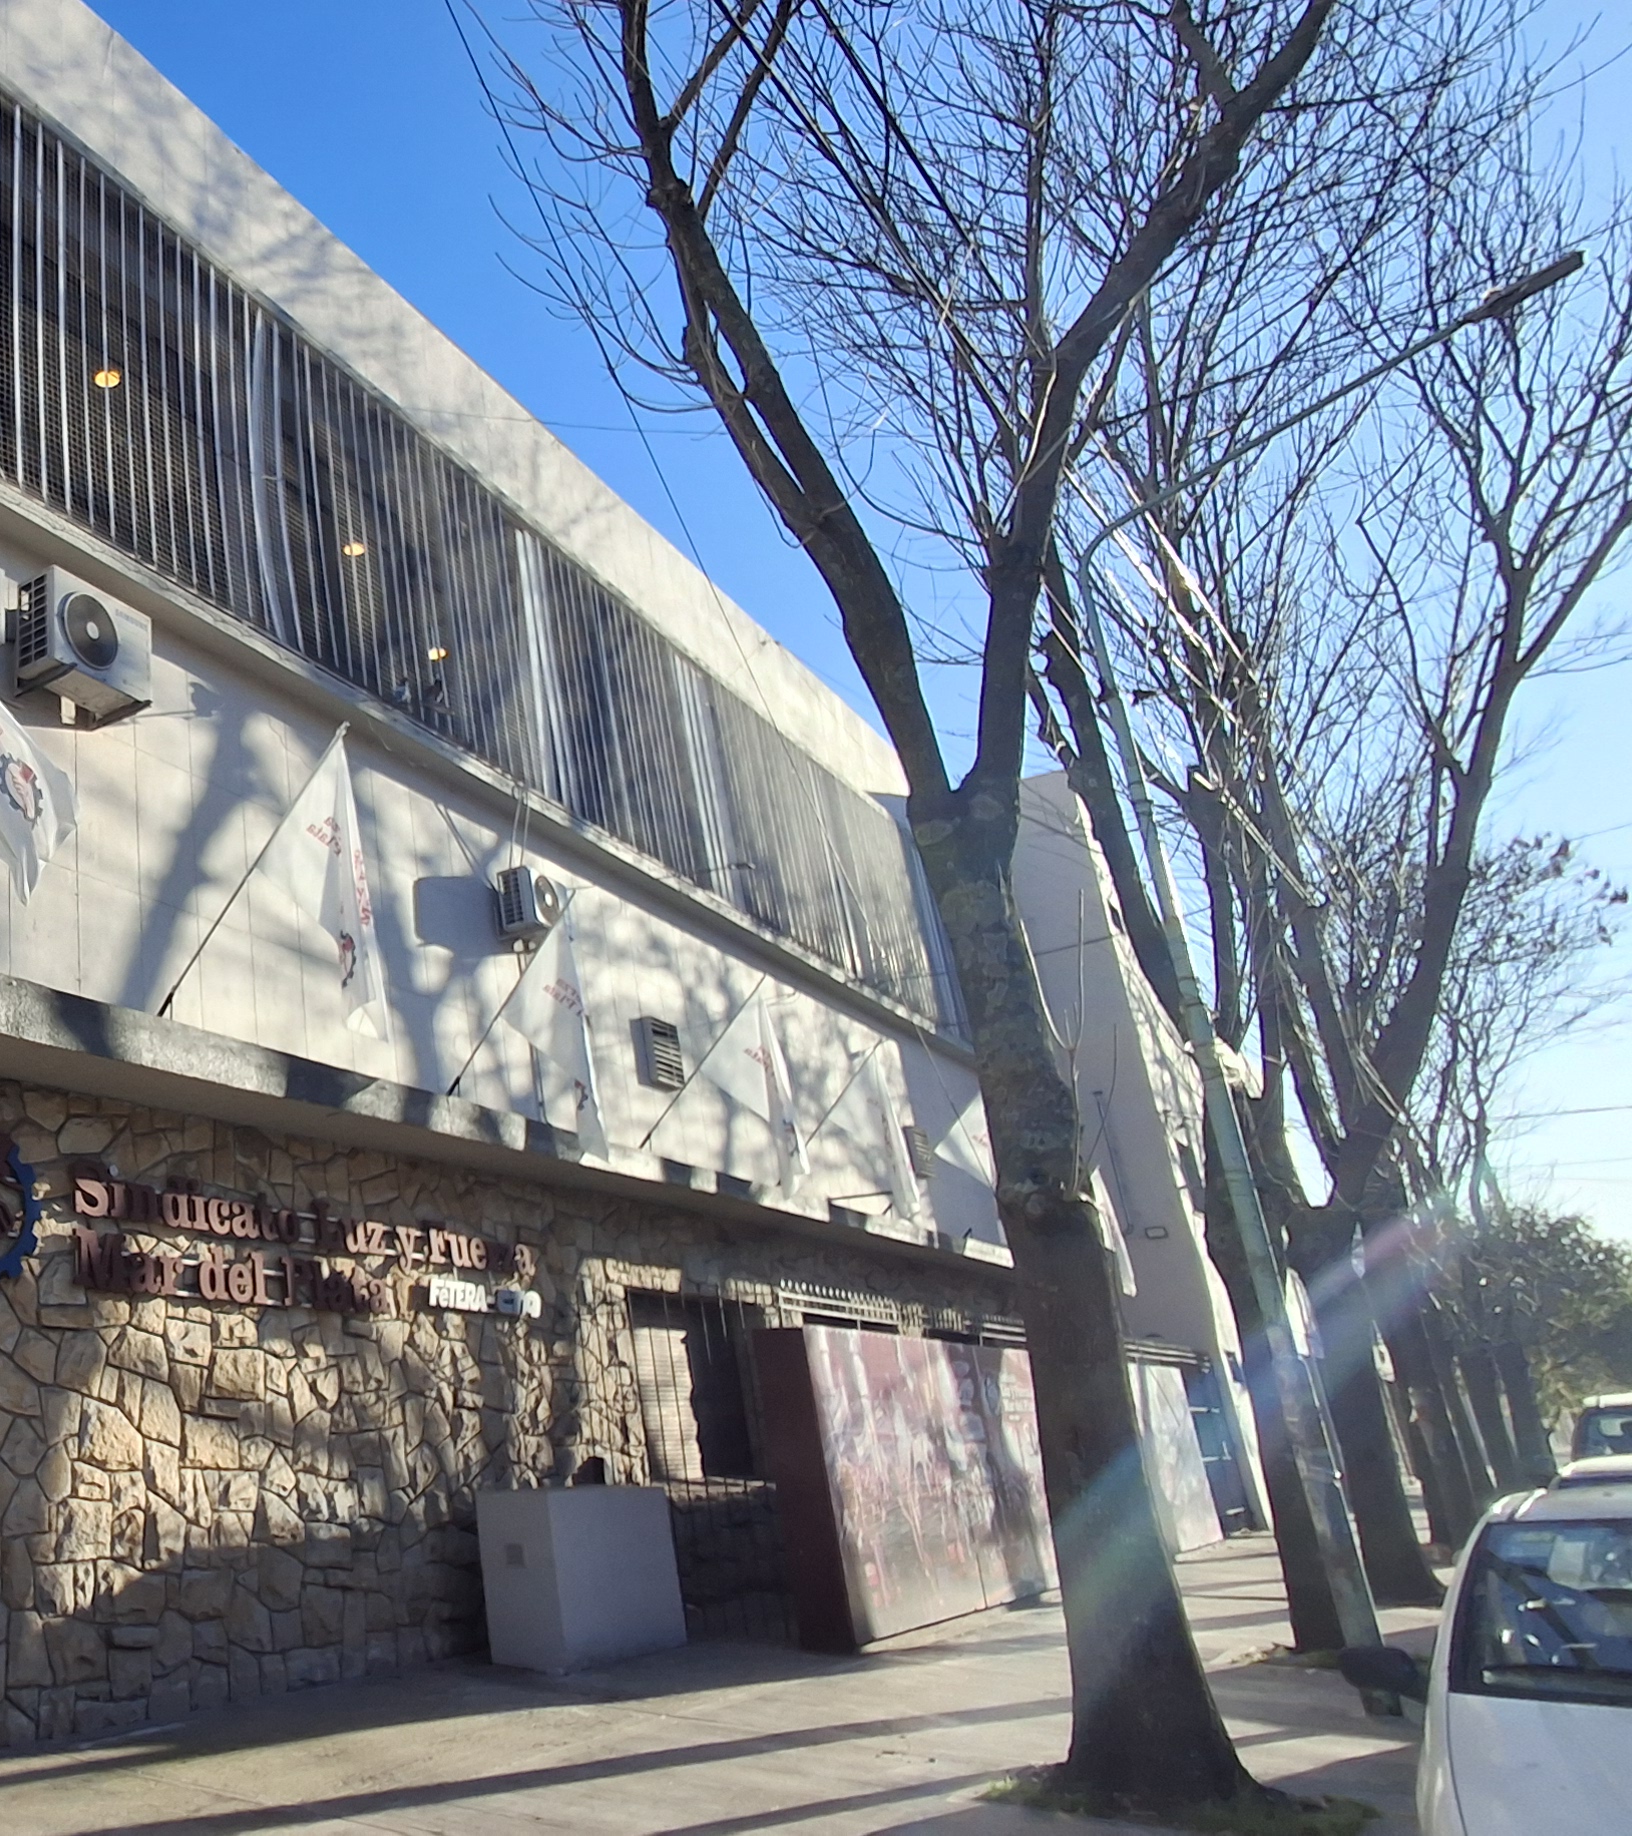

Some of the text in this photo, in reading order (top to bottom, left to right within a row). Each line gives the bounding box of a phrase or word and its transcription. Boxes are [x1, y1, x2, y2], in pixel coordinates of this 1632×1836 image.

[70, 1161, 300, 1244] Sindicato
[394, 1225, 419, 1275] y
[72, 1227, 395, 1317] Mar del Plata
